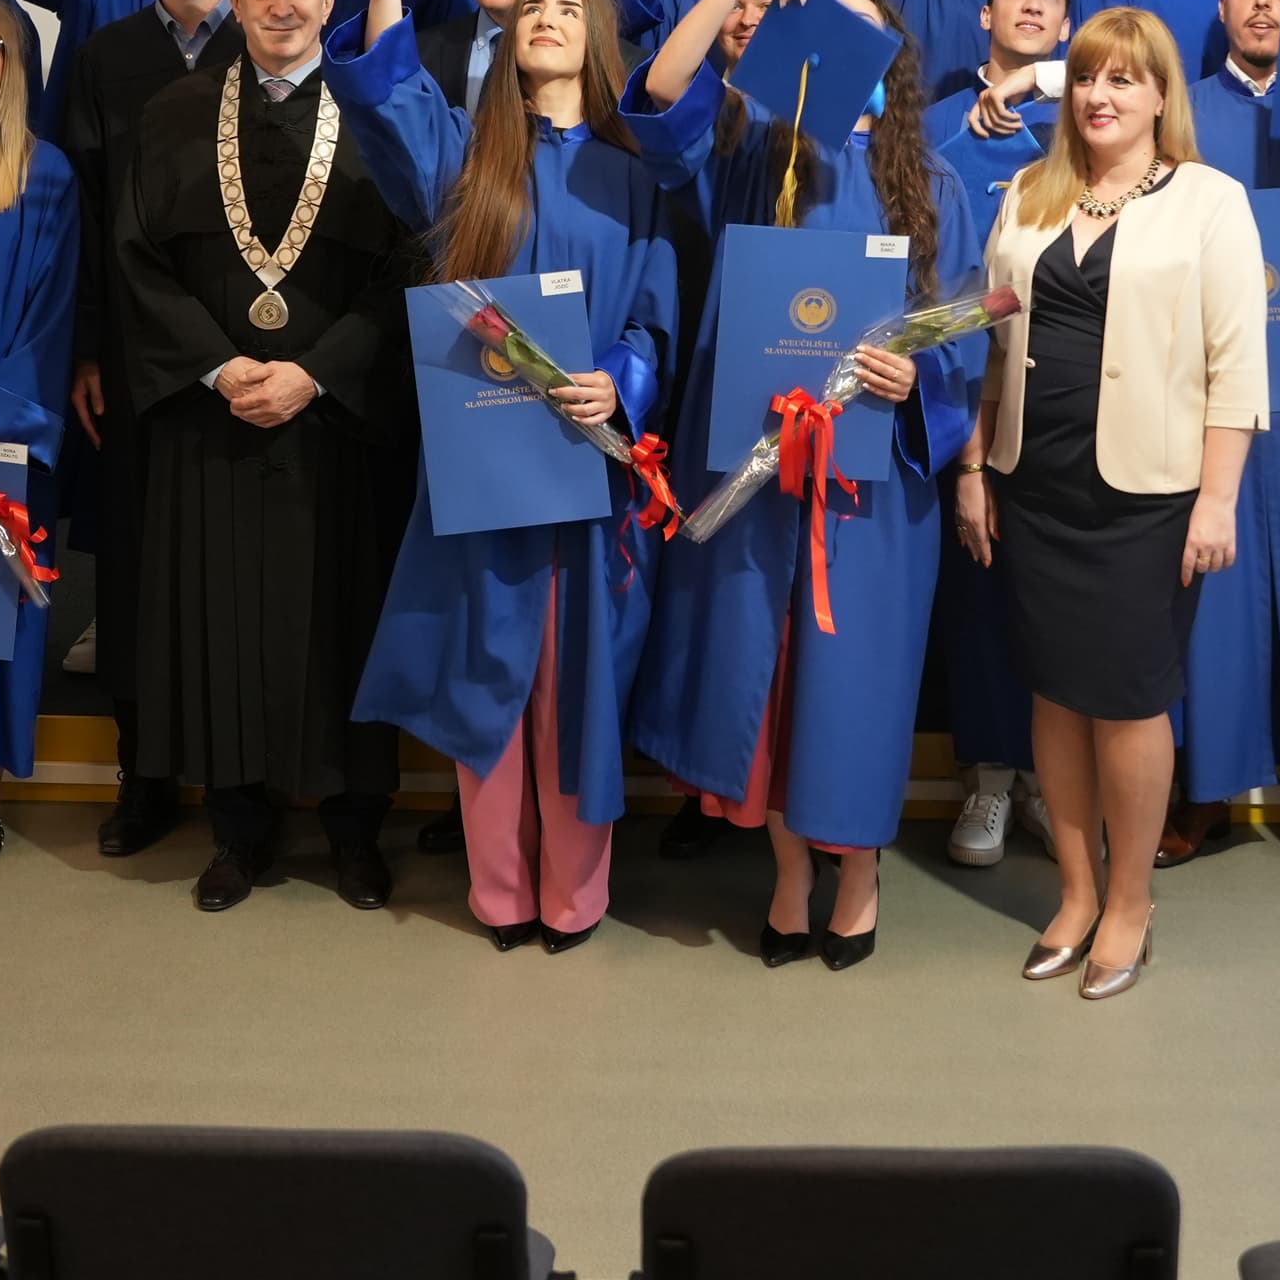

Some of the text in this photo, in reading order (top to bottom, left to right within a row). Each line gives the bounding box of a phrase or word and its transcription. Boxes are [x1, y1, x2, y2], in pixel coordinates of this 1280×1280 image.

[779, 338, 832, 348] SVEUČILIŠTE
[764, 347, 821, 357] SLAVONSKOM
[477, 384, 529, 399] SVEUČILIŠTE
[464, 396, 521, 409] SLAVONSKOM
